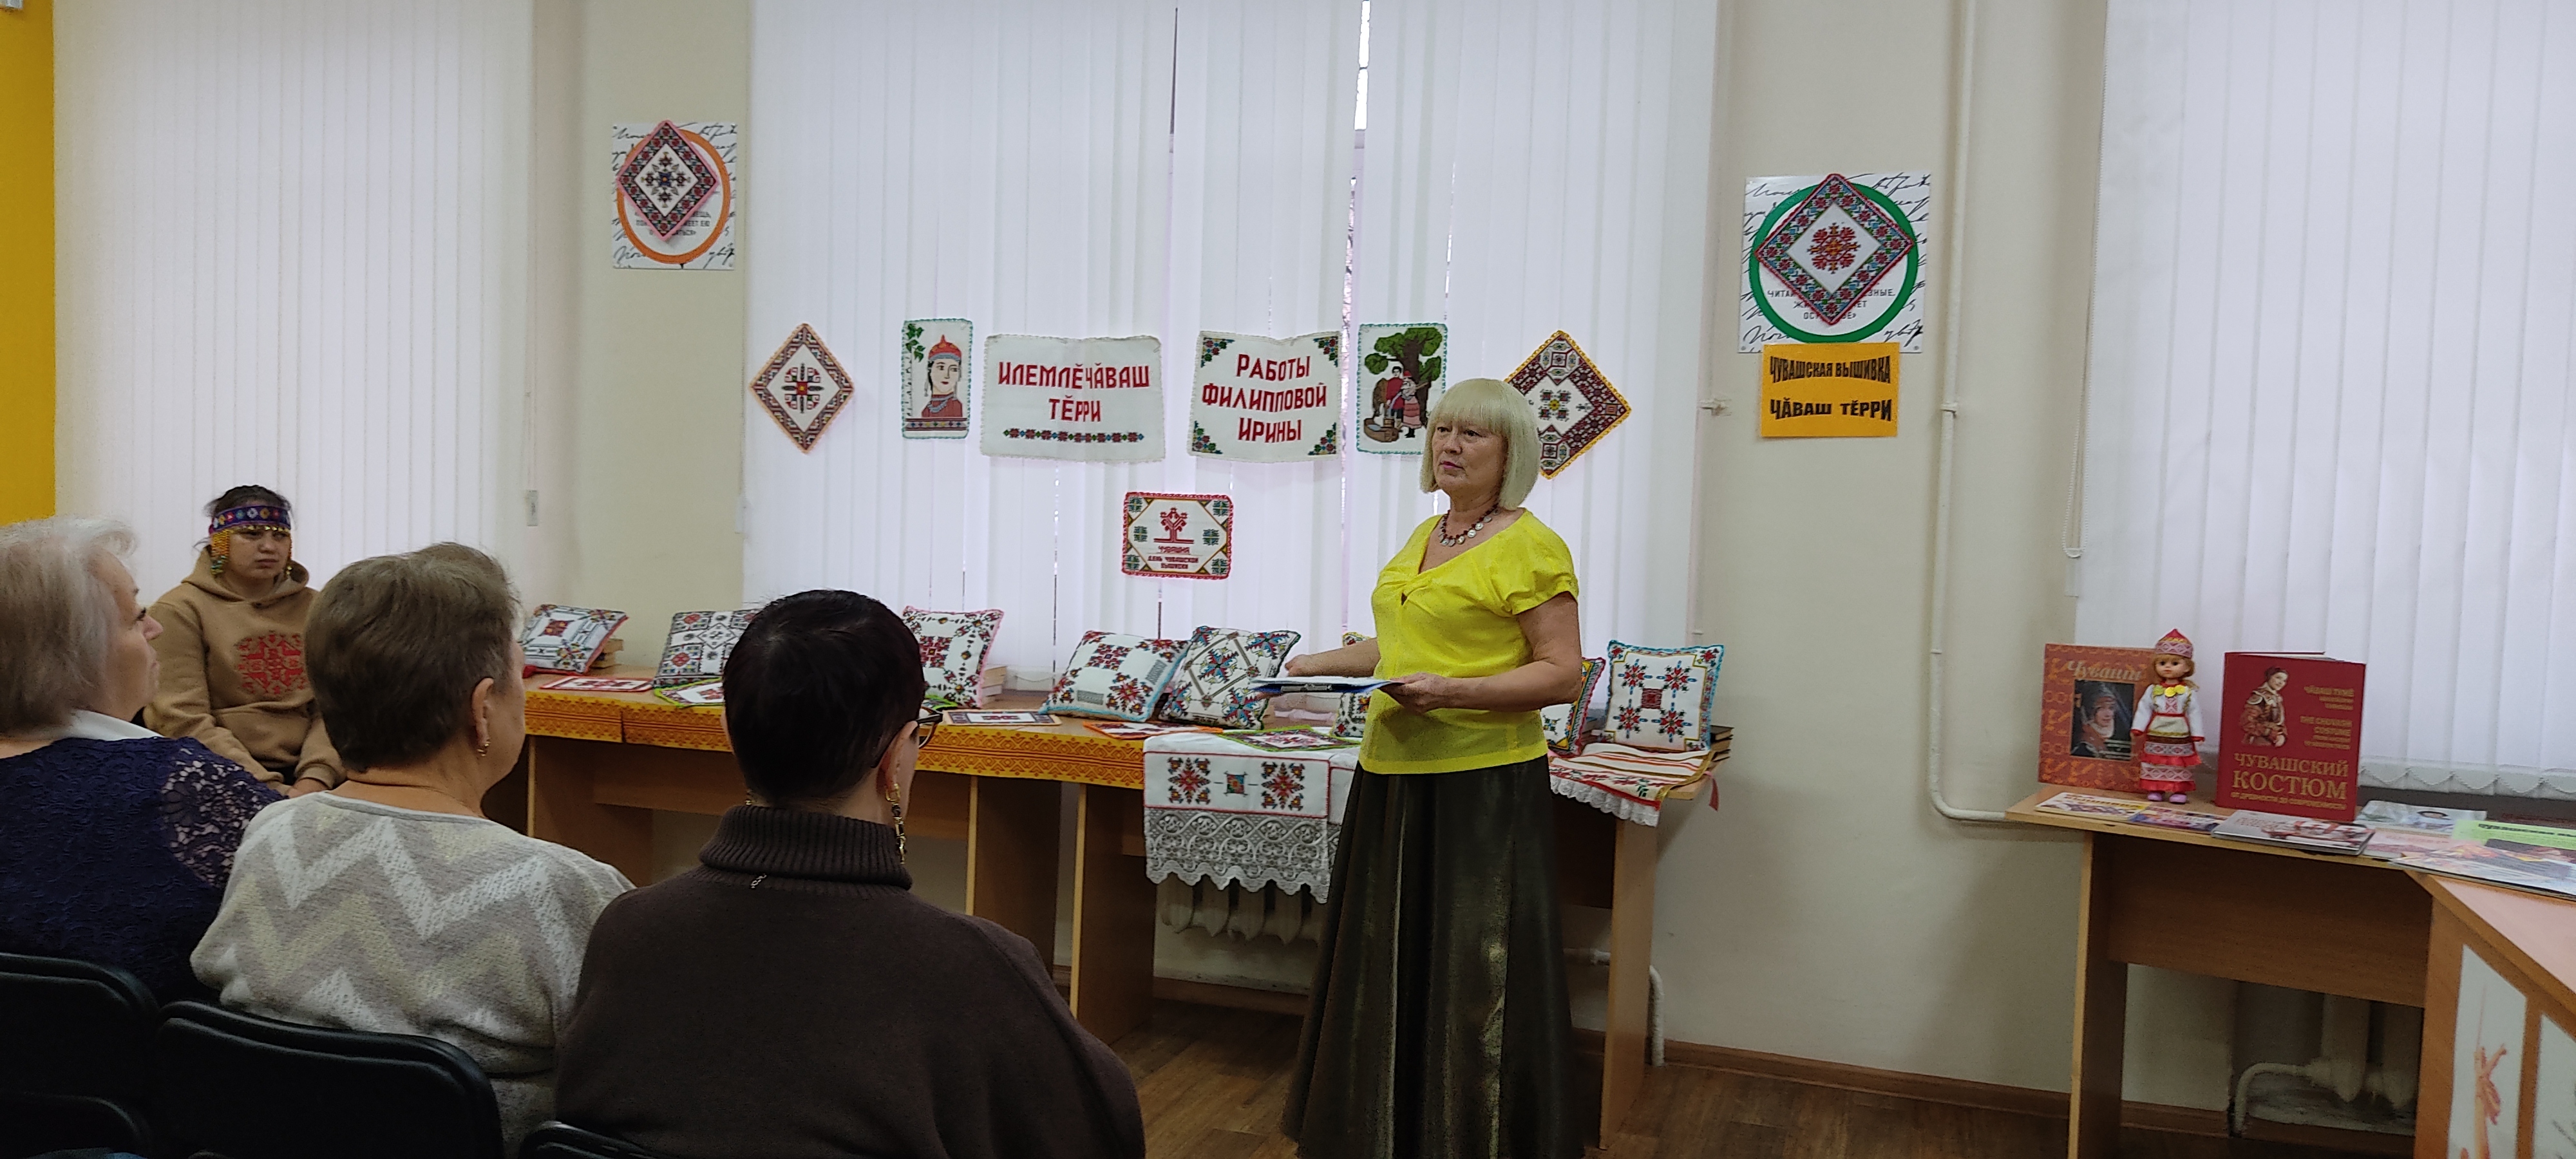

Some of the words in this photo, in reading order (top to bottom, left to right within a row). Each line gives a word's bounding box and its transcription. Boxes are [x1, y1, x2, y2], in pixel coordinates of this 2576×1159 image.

[1235, 353, 1311, 381] РАБОТЫ
[1770, 356, 1833, 384] ЧУВАШСКАЯ
[1835, 355, 1891, 384] ВЫШИВКА
[1202, 382, 1327, 412] ФИЛИППОВОЙ
[1238, 417, 1302, 443] ИРИНЫ
[2233, 752, 2349, 777] ЧУВАШСКИЙ
[2232, 770, 2347, 800] КОСТЮМ
